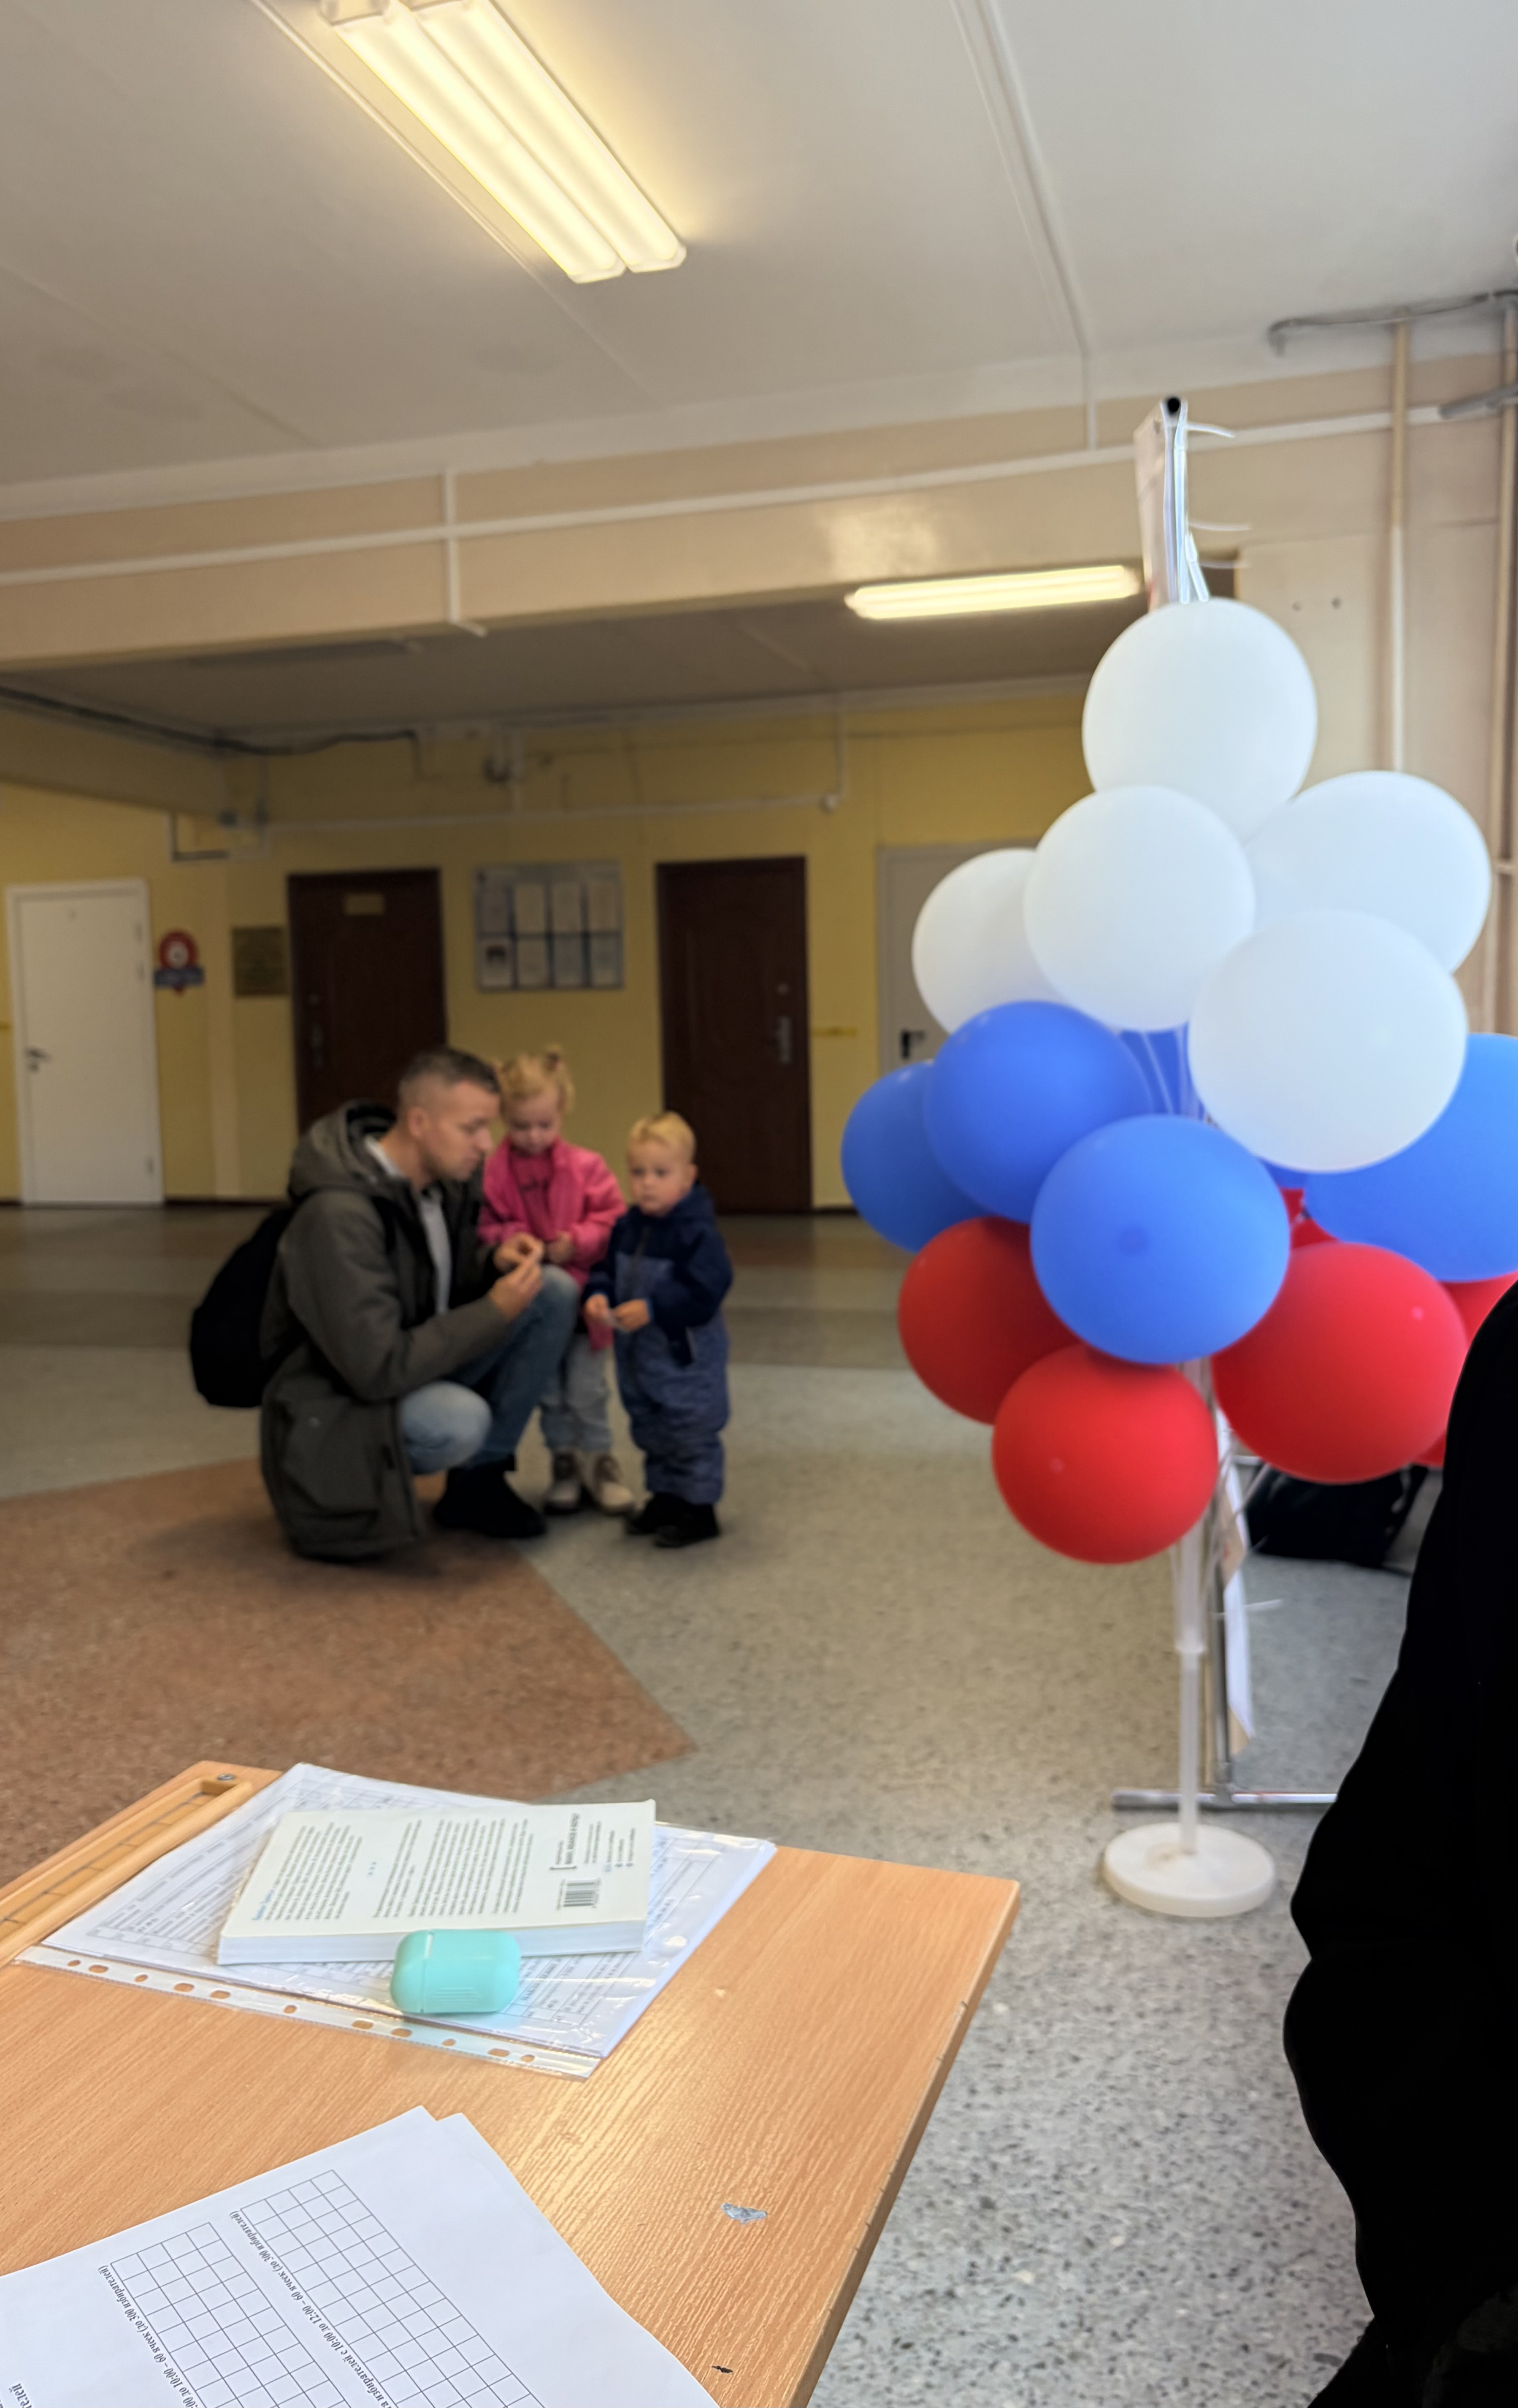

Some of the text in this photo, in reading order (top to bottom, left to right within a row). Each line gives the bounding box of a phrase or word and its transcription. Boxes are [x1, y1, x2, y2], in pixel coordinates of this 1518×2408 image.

[229, 2210, 265, 2251] избирателей)
[259, 2250, 274, 2262] 300
[270, 2261, 283, 2272] (до
[98, 2265, 131, 2308] избирателей)
[278, 2271, 297, 2291] ячеек
[291, 2292, 303, 2300] 60
[124, 2308, 139, 2321] 300
[302, 2305, 322, 2324] 12:00
[135, 2321, 148, 2332] (до
[319, 2323, 330, 2332] до
[142, 2331, 160, 2353] ячеек
[323, 2332, 344, 2351] 10:00
[154, 2353, 166, 2362] 60
[163, 2368, 183, 2388] 10:00
[342, 2354, 384, 2401] избирателей
[179, 2387, 191, 2397] до
[182, 2397, 200, 2408] :00
